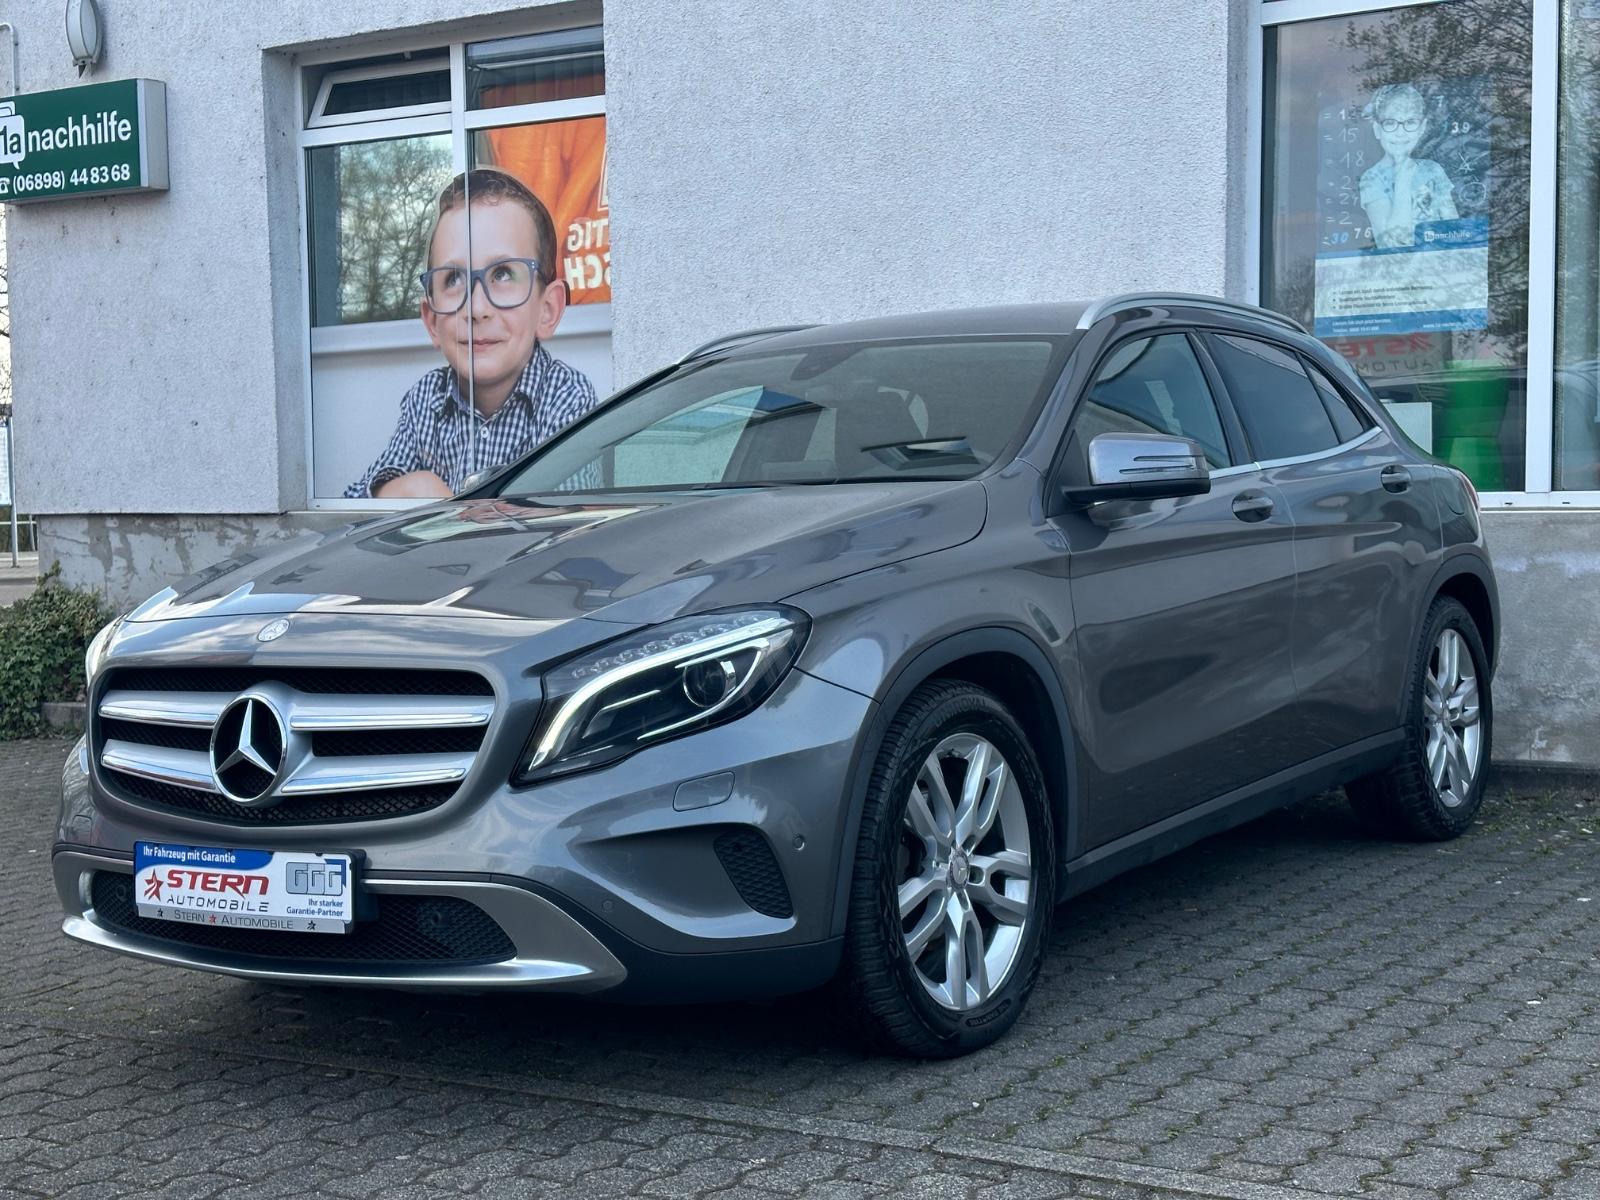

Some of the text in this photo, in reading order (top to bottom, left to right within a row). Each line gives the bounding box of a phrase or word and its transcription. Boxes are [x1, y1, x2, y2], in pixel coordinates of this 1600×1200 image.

[27, 110, 132, 153] nachhilfe
[13, 170, 65, 195] (06898)
[143, 845, 236, 863] Ihr Fahrzeug mit Garantie
[167, 869, 269, 899] STERN
[167, 894, 269, 912] AUTOMOBILE
[286, 906, 344, 917] Garantie-Partner
[308, 898, 344, 907] Ihr starker
